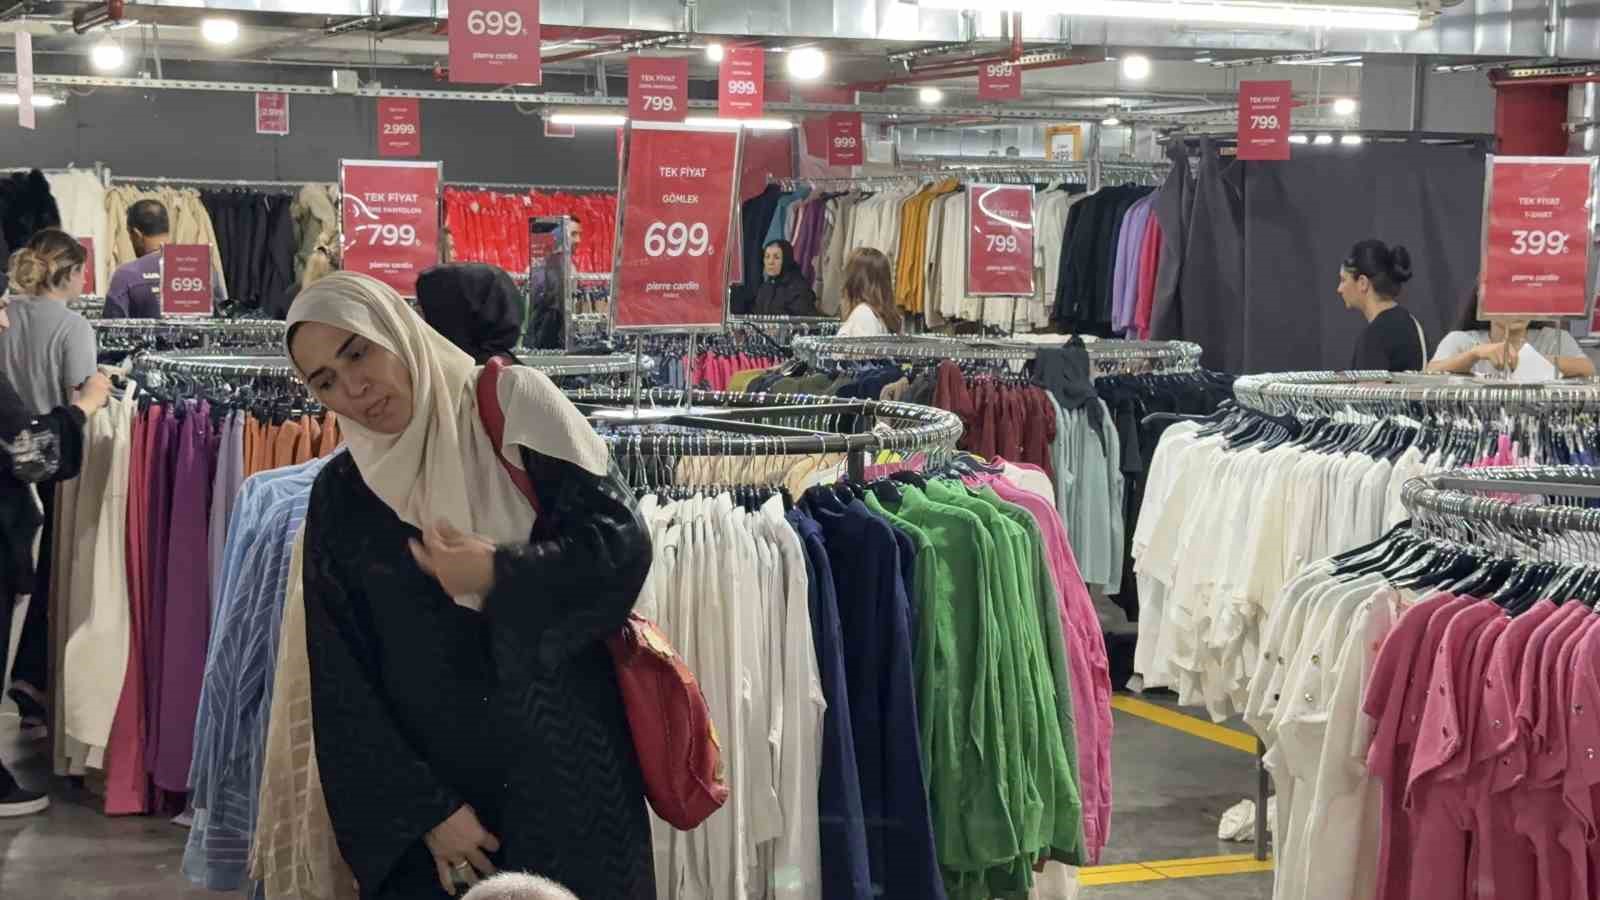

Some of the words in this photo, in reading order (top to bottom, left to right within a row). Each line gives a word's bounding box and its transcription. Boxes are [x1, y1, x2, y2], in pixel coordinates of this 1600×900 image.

[659, 167, 678, 177] TEK
[680, 166, 707, 178] FİYAT
[363, 192, 386, 202] TEK
[387, 191, 419, 203] FİYAT
[662, 192, 699, 204] GÖMLEK
[646, 281, 671, 293] pierre
[672, 281, 700, 291] cardin
